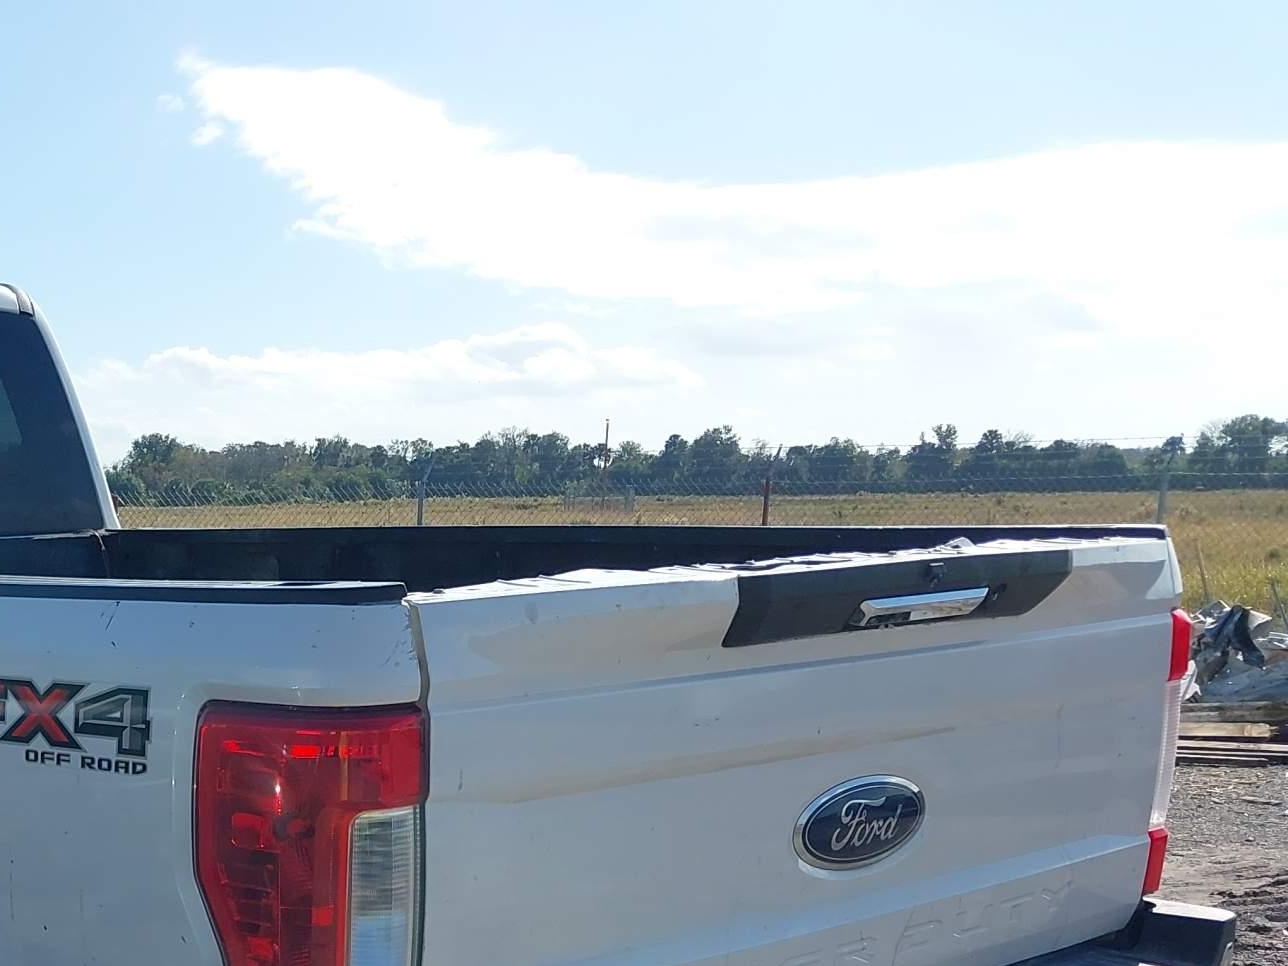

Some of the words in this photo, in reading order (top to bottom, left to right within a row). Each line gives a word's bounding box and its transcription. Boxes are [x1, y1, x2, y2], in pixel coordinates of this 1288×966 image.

[24, 748, 71, 766] OFF
[80, 755, 148, 776] ROAD
[830, 795, 903, 851] Ford
